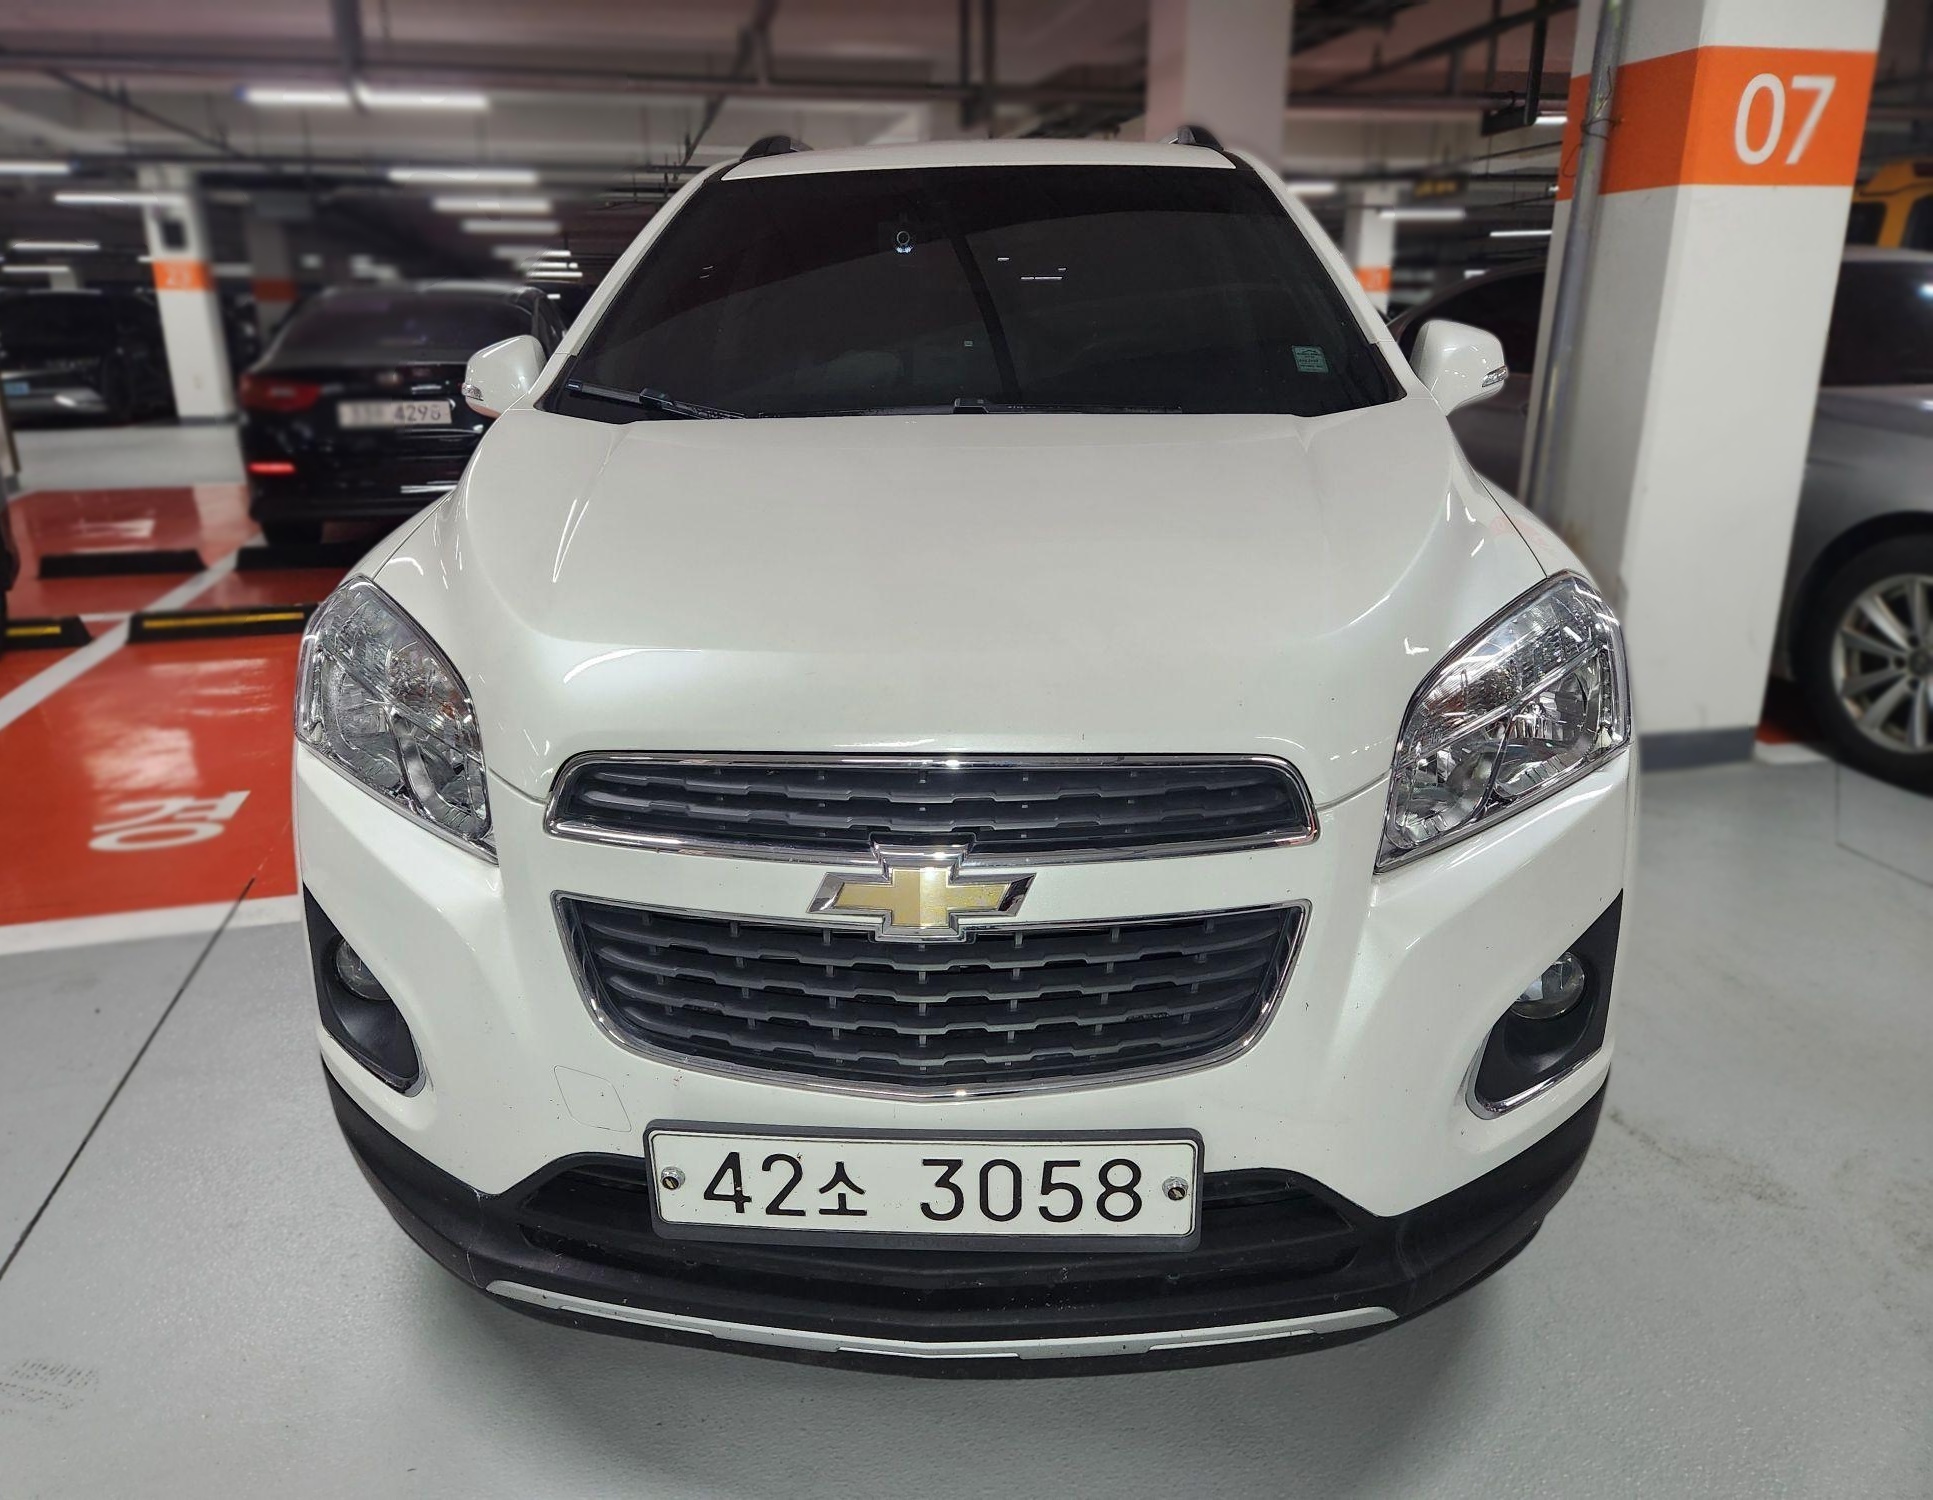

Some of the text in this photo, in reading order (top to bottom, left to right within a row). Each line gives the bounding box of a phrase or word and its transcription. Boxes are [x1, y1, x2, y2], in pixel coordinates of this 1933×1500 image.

[1734, 72, 1837, 166] 07
[88, 790, 252, 851] 경
[703, 1151, 1143, 1222] 42소 3058
